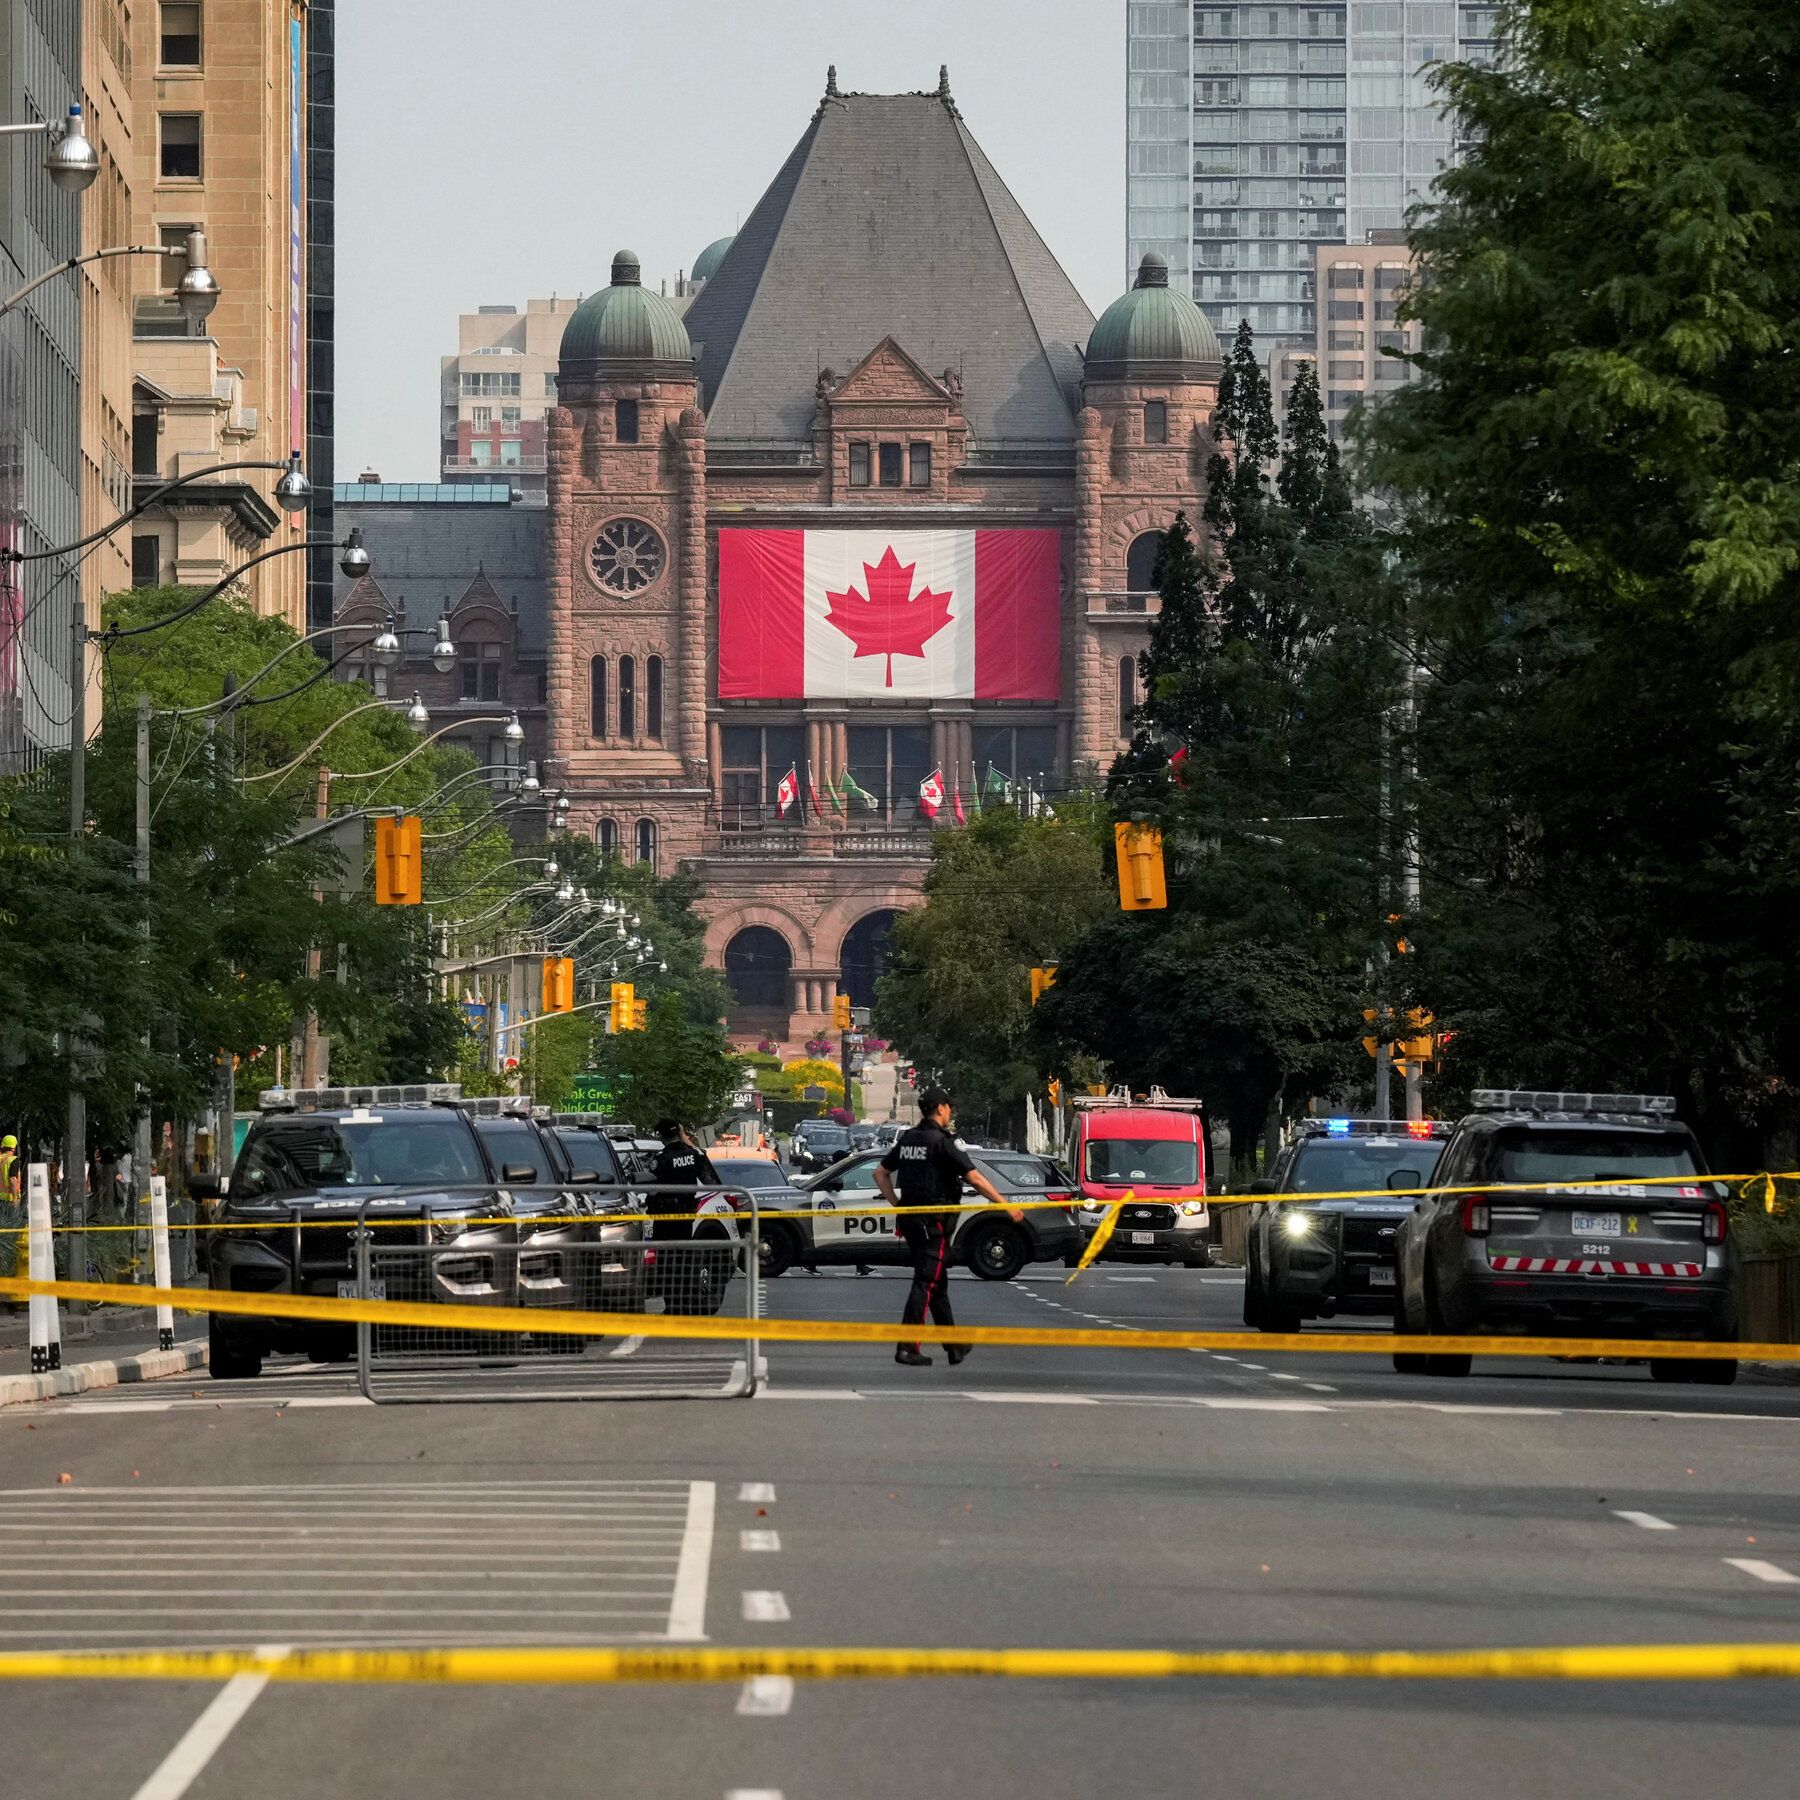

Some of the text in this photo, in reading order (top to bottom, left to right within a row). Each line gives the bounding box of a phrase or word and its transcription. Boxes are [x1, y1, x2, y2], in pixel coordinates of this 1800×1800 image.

[734, 1093, 752, 1102] EAST
[560, 1102, 616, 1113] hink Clea
[900, 1146, 927, 1160] POLICE
[673, 1154, 695, 1168] POLICE
[1546, 1183, 1647, 1198] POLICE
[1582, 1244, 1610, 1255] 5212
